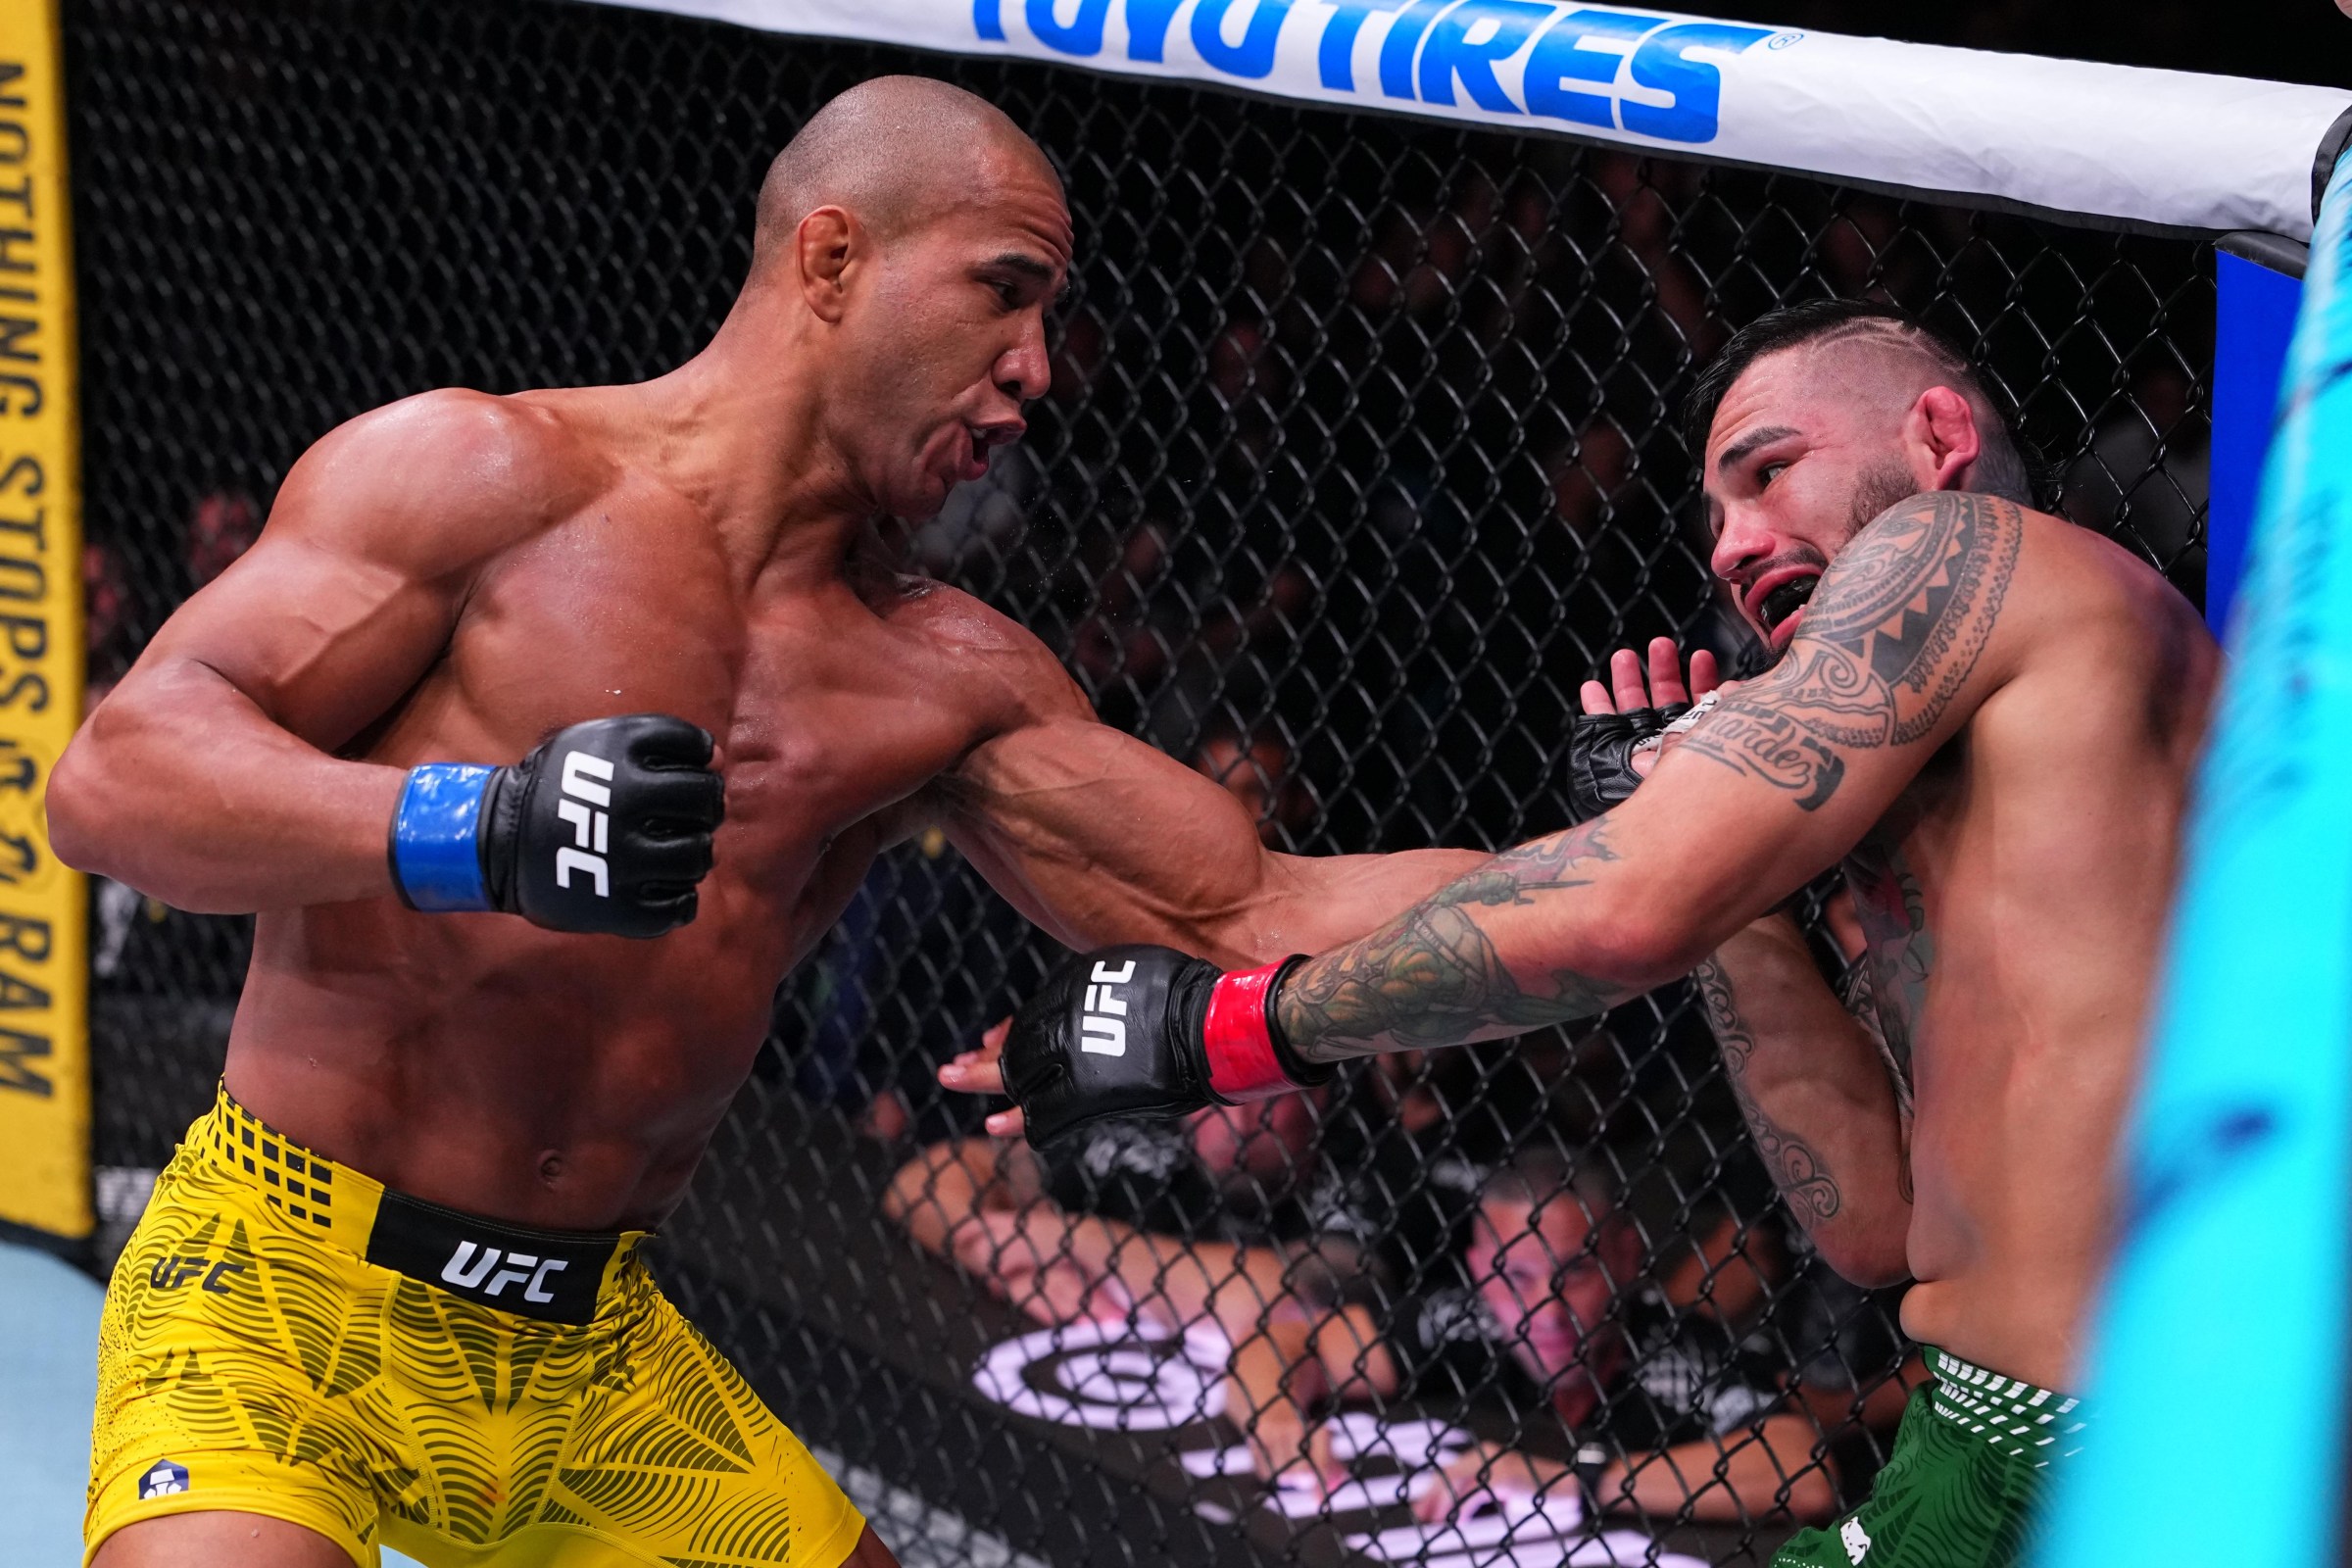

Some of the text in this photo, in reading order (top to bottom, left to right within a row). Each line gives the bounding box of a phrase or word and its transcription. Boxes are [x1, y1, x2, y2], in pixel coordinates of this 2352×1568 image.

[1318, 0, 1778, 144] TIRES
[0, 455, 49, 712] STOPS
[556, 750, 615, 898] UFC
[0, 910, 54, 1098] RAM
[1081, 960, 1136, 1057] UFC
[150, 1256, 246, 1295] UFC
[441, 1240, 569, 1303] UFC
